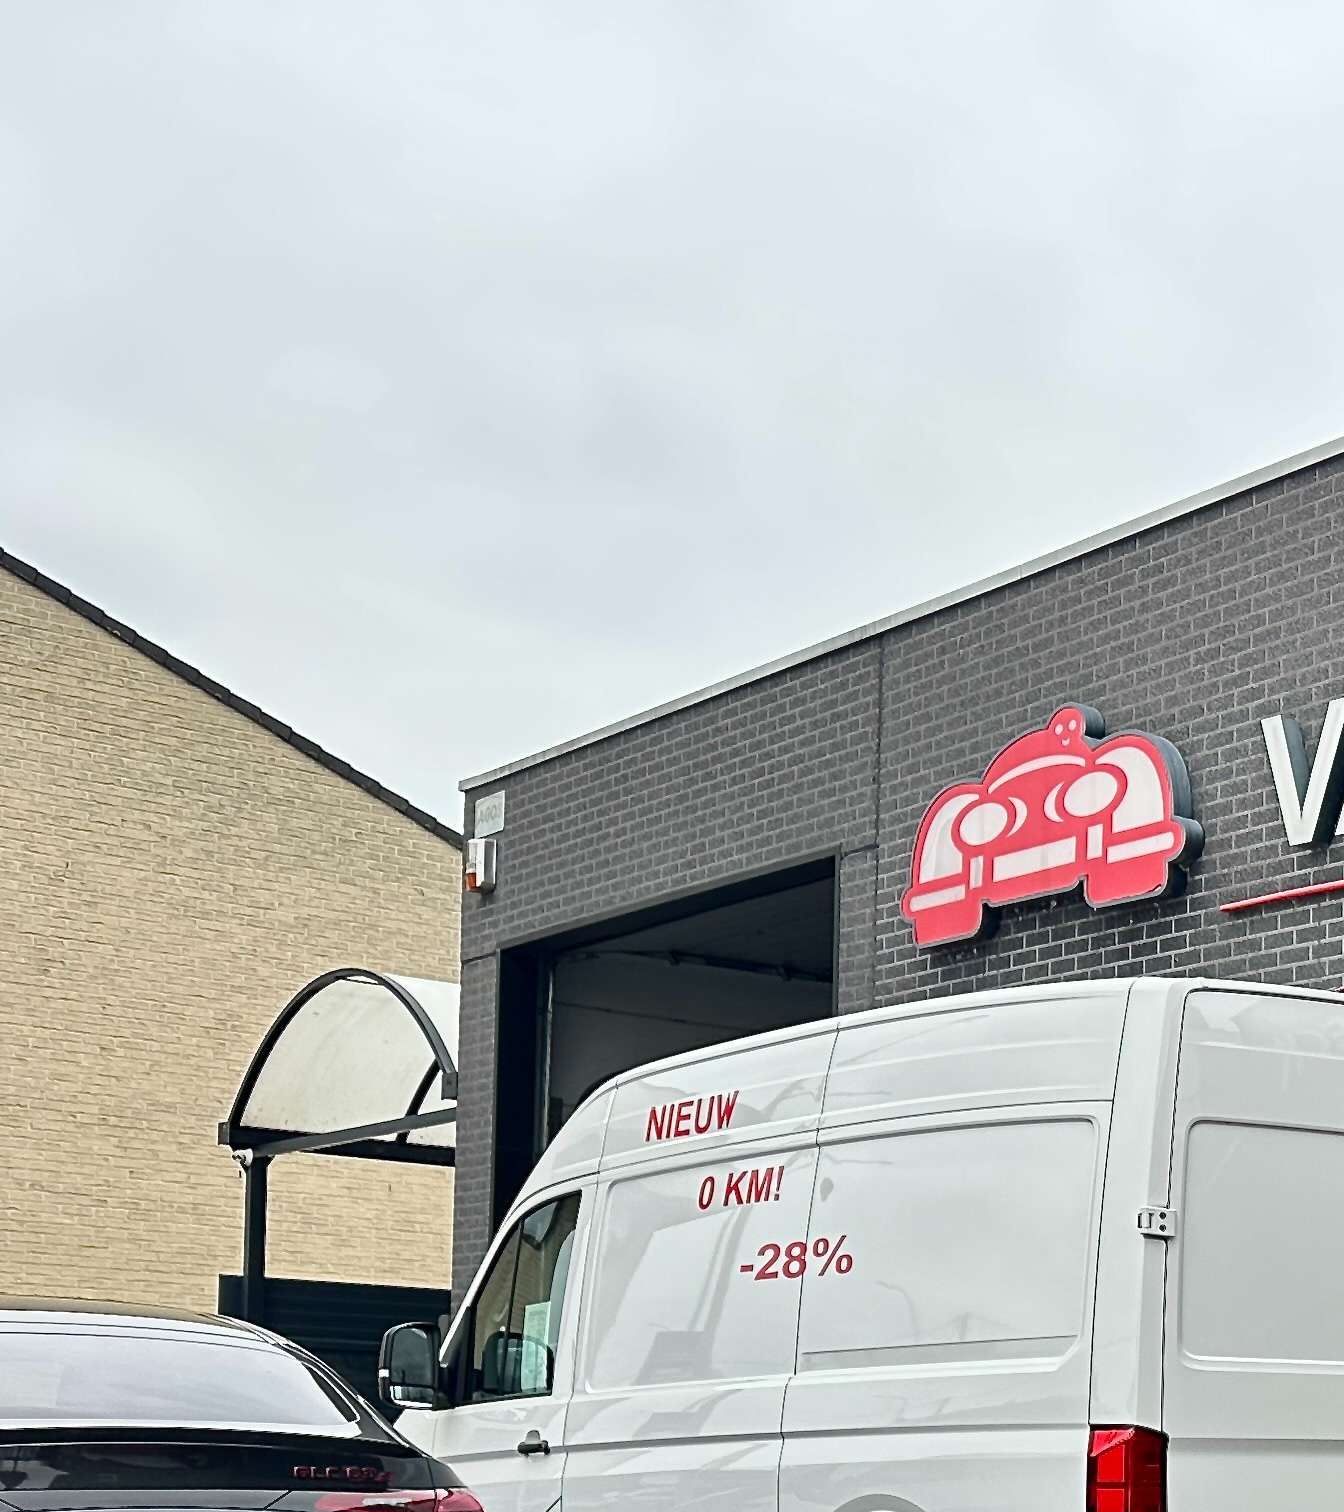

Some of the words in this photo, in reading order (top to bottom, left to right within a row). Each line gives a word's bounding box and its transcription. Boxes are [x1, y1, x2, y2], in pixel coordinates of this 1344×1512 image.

[645, 1090, 739, 1142] NIEUW
[698, 1176, 715, 1210] 0
[723, 1165, 784, 1206] KM!
[740, 1235, 853, 1280] -28%
